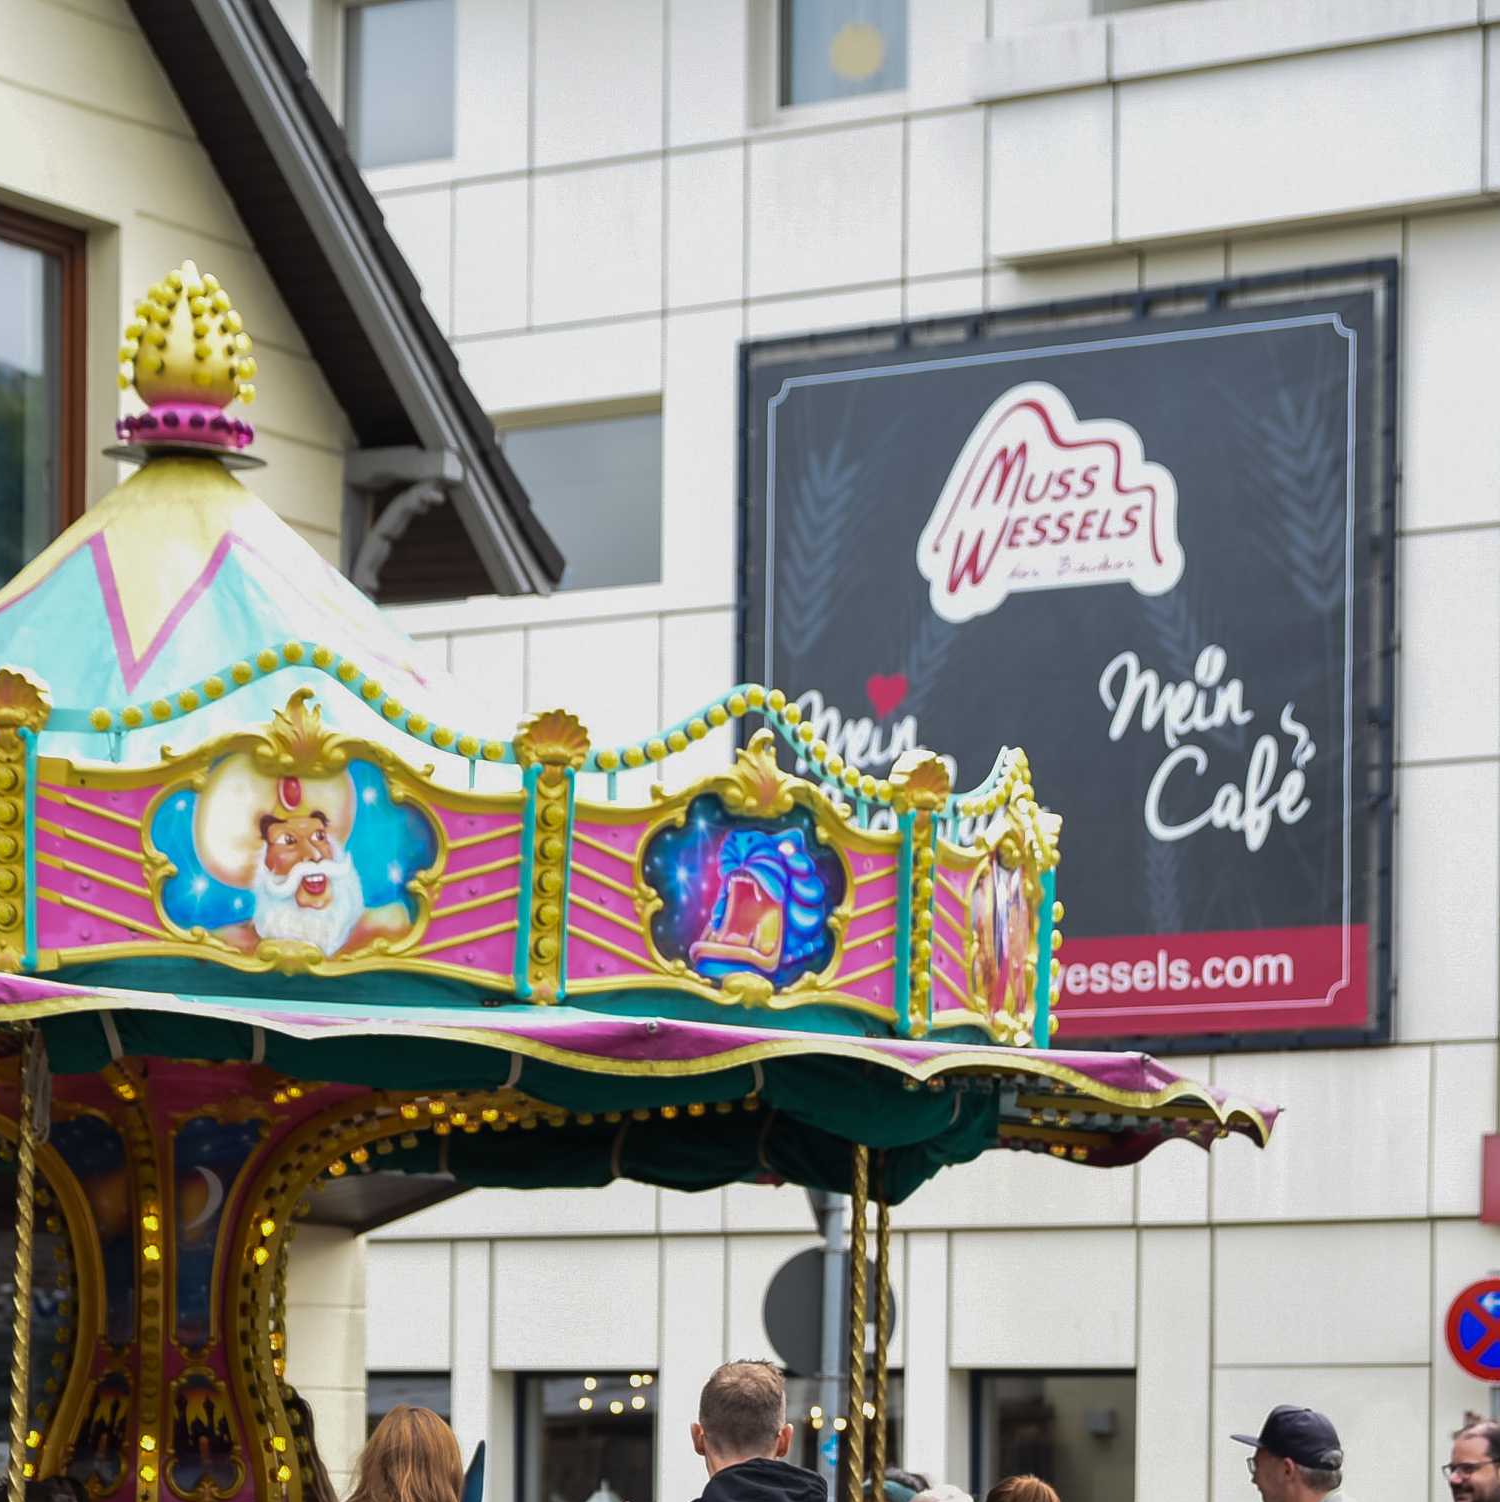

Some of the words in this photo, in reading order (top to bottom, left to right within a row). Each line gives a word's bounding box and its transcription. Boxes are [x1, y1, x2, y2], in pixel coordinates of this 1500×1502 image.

[970, 441, 1100, 510] MUSS
[947, 504, 1143, 595] WESSELS
[1099, 644, 1255, 749] Mein
